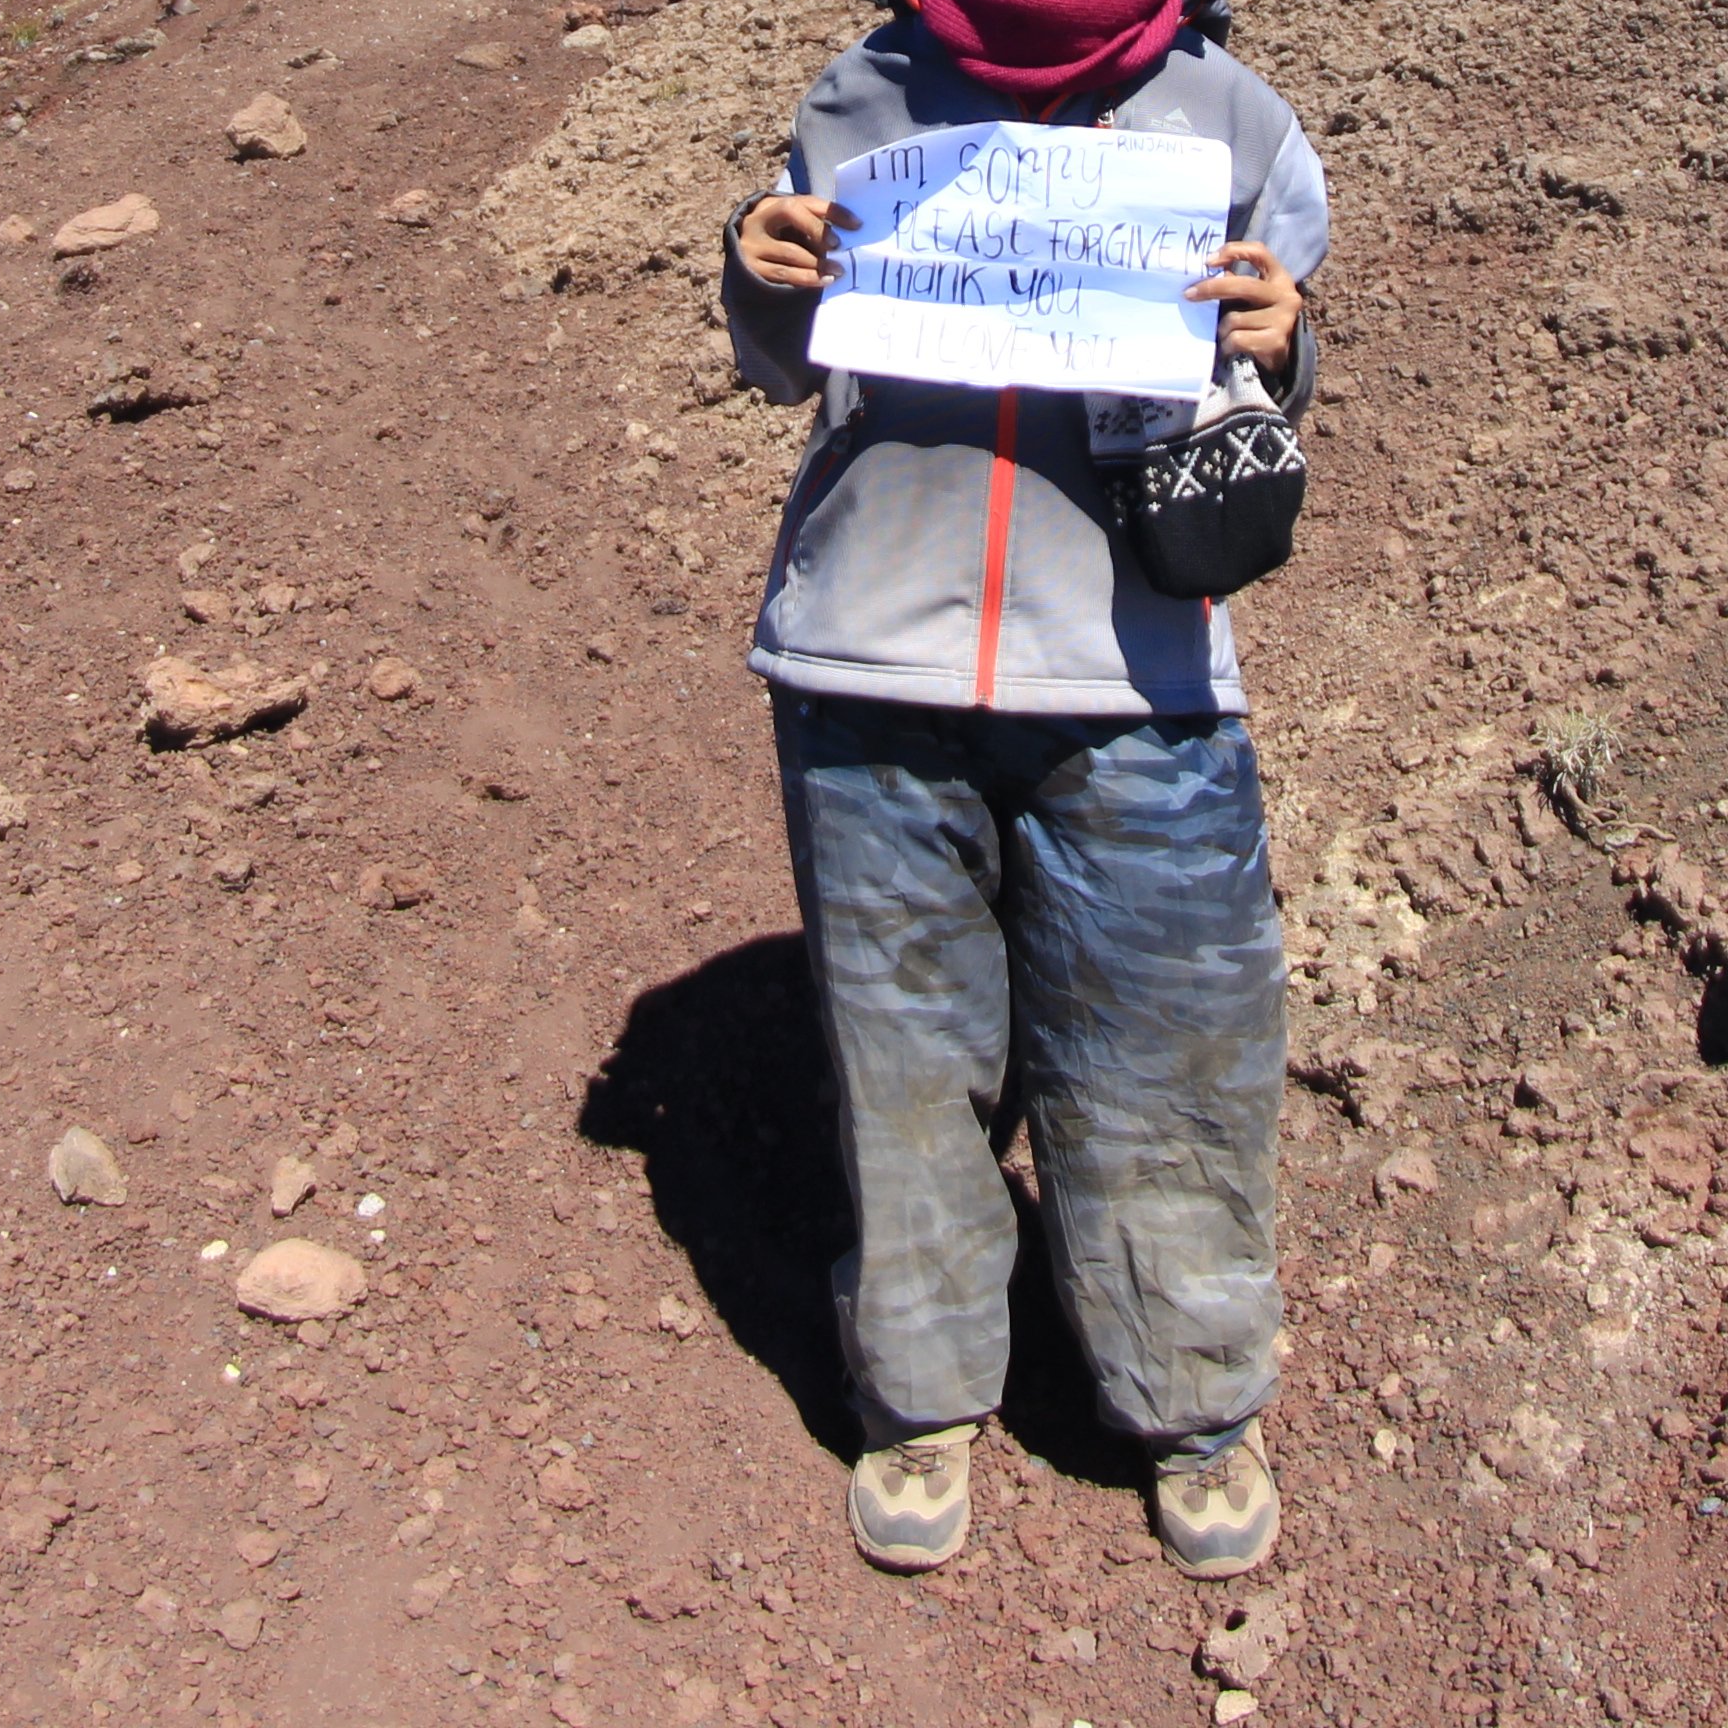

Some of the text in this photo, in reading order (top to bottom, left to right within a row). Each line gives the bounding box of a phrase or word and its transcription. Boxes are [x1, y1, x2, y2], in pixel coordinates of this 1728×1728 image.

[868, 143, 926, 190] I'm
[892, 199, 1035, 259] PLEASE
[1048, 218, 1177, 270] FORGIVE
